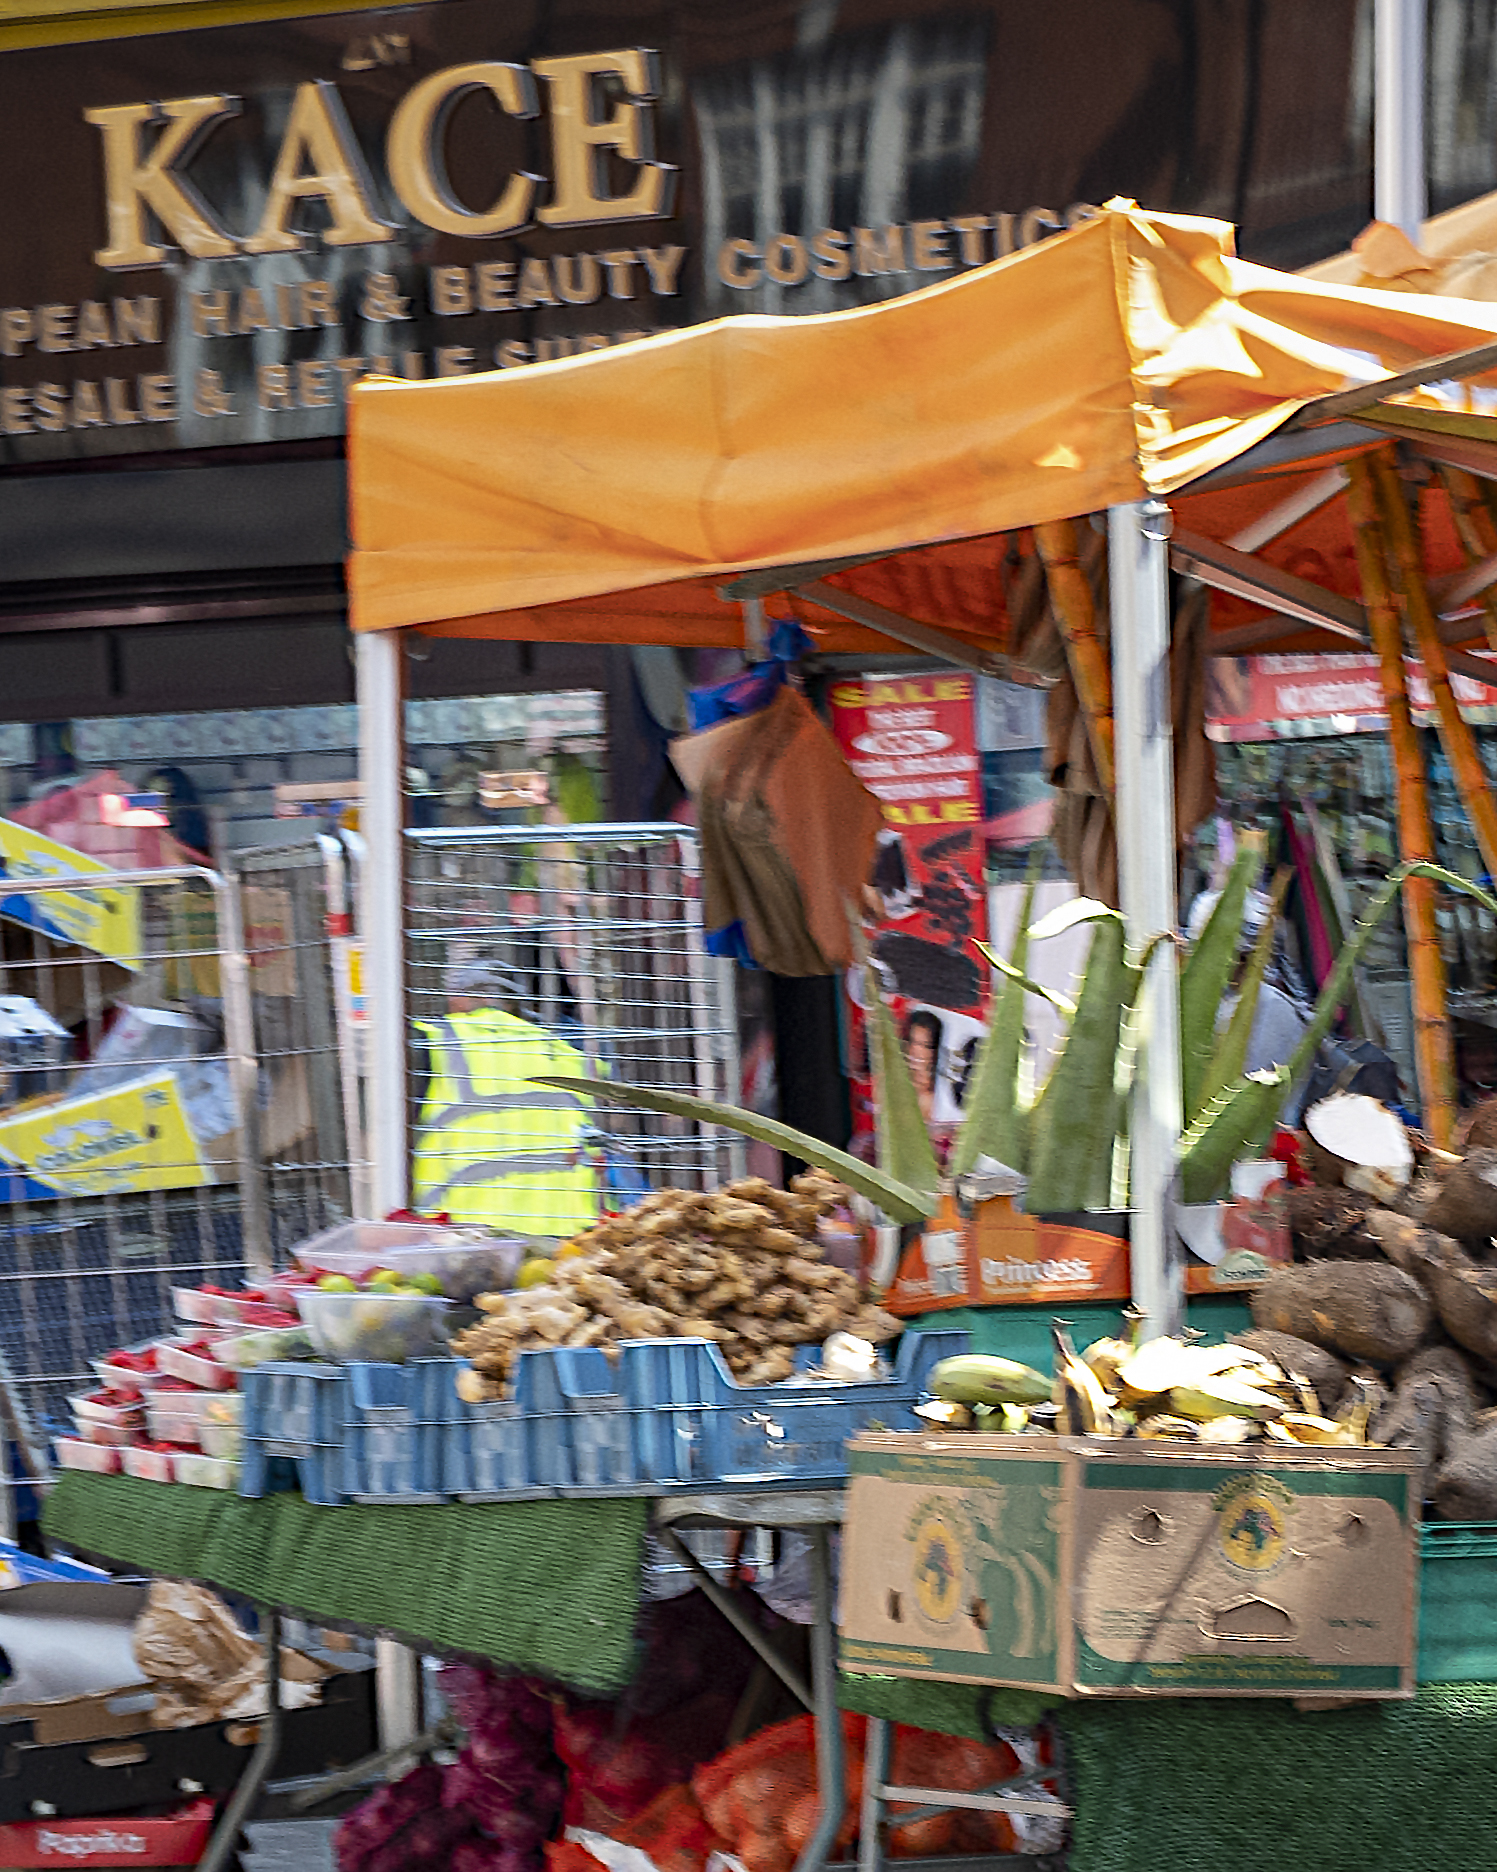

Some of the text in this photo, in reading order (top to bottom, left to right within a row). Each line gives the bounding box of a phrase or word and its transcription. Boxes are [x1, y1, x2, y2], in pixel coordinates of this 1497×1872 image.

[84, 47, 682, 271] KACE
[191, 279, 343, 338] HAIR
[357, 270, 412, 323] &
[430, 244, 687, 316] BEAUTY
[192, 366, 238, 418] &
[831, 679, 972, 708] SALE
[880, 802, 981, 825] ALE
